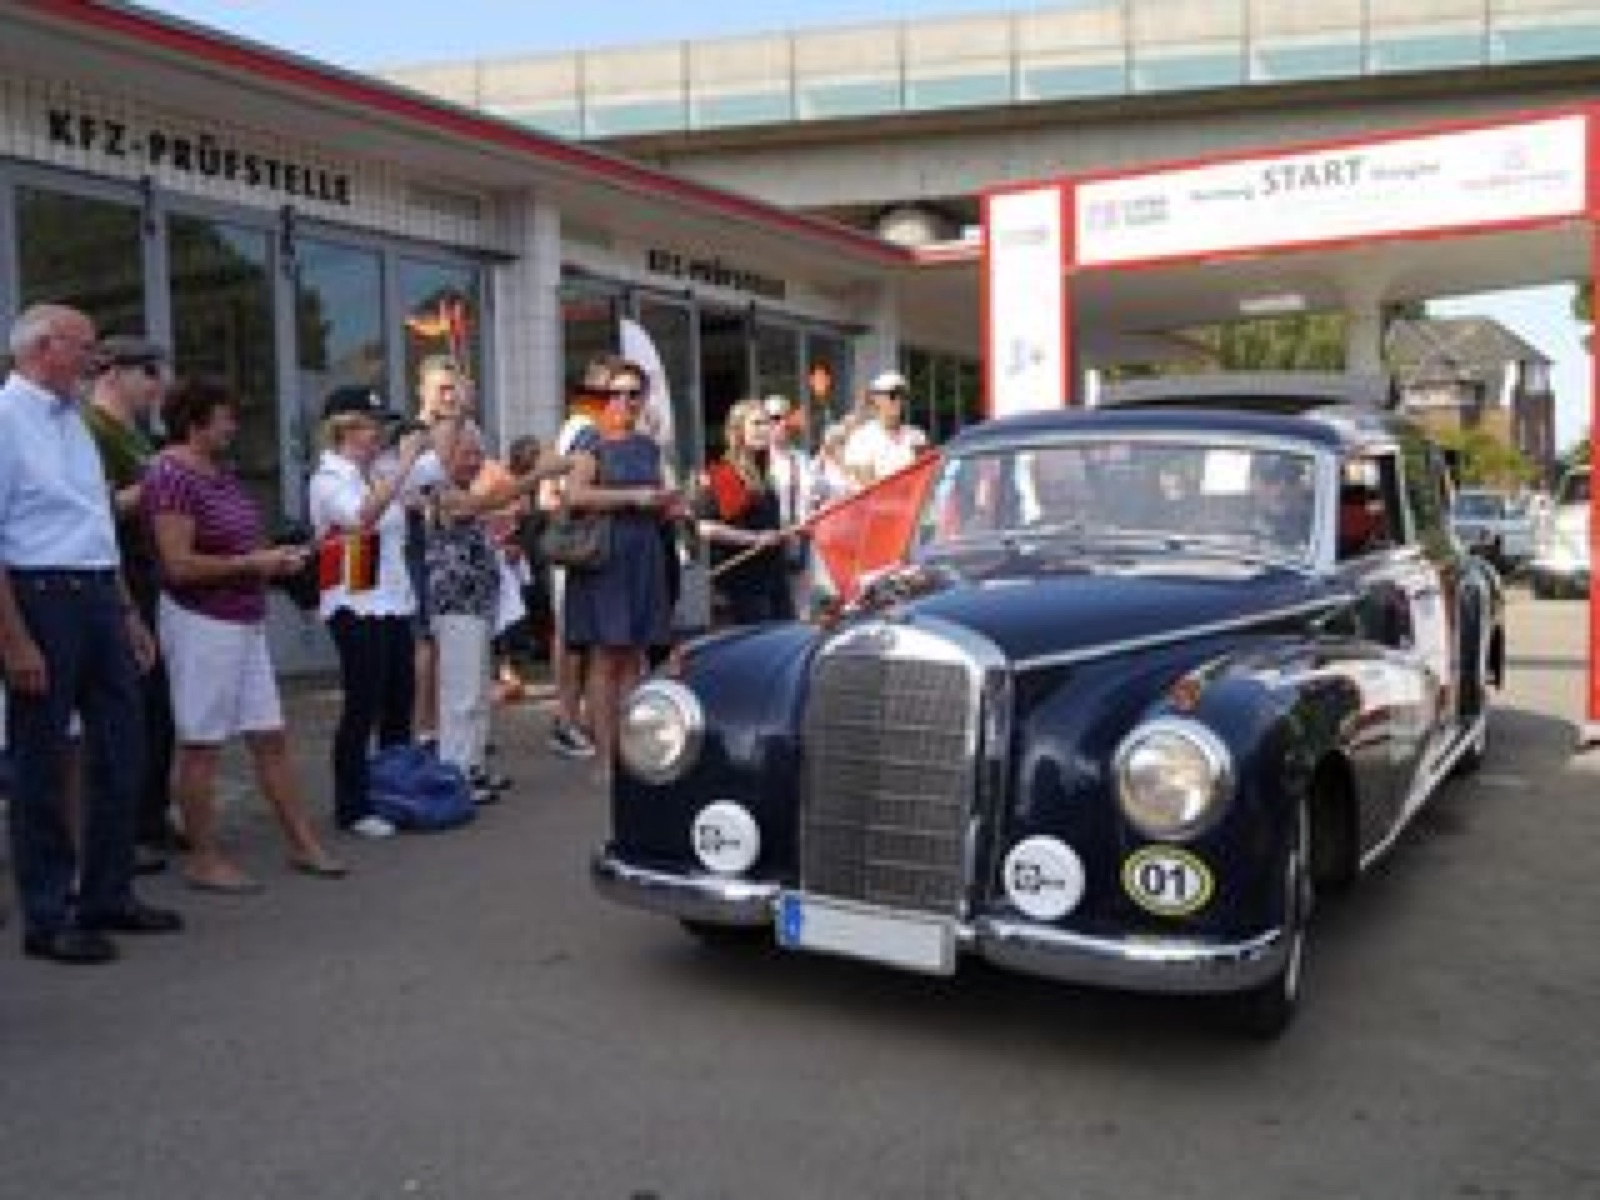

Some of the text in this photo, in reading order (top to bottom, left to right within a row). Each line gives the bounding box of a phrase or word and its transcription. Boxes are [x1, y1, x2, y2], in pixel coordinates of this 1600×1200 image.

[48, 108, 350, 205] KFZ-PRÜFSTELLE
[1261, 156, 1363, 196] START
[1139, 864, 1186, 900] 01
